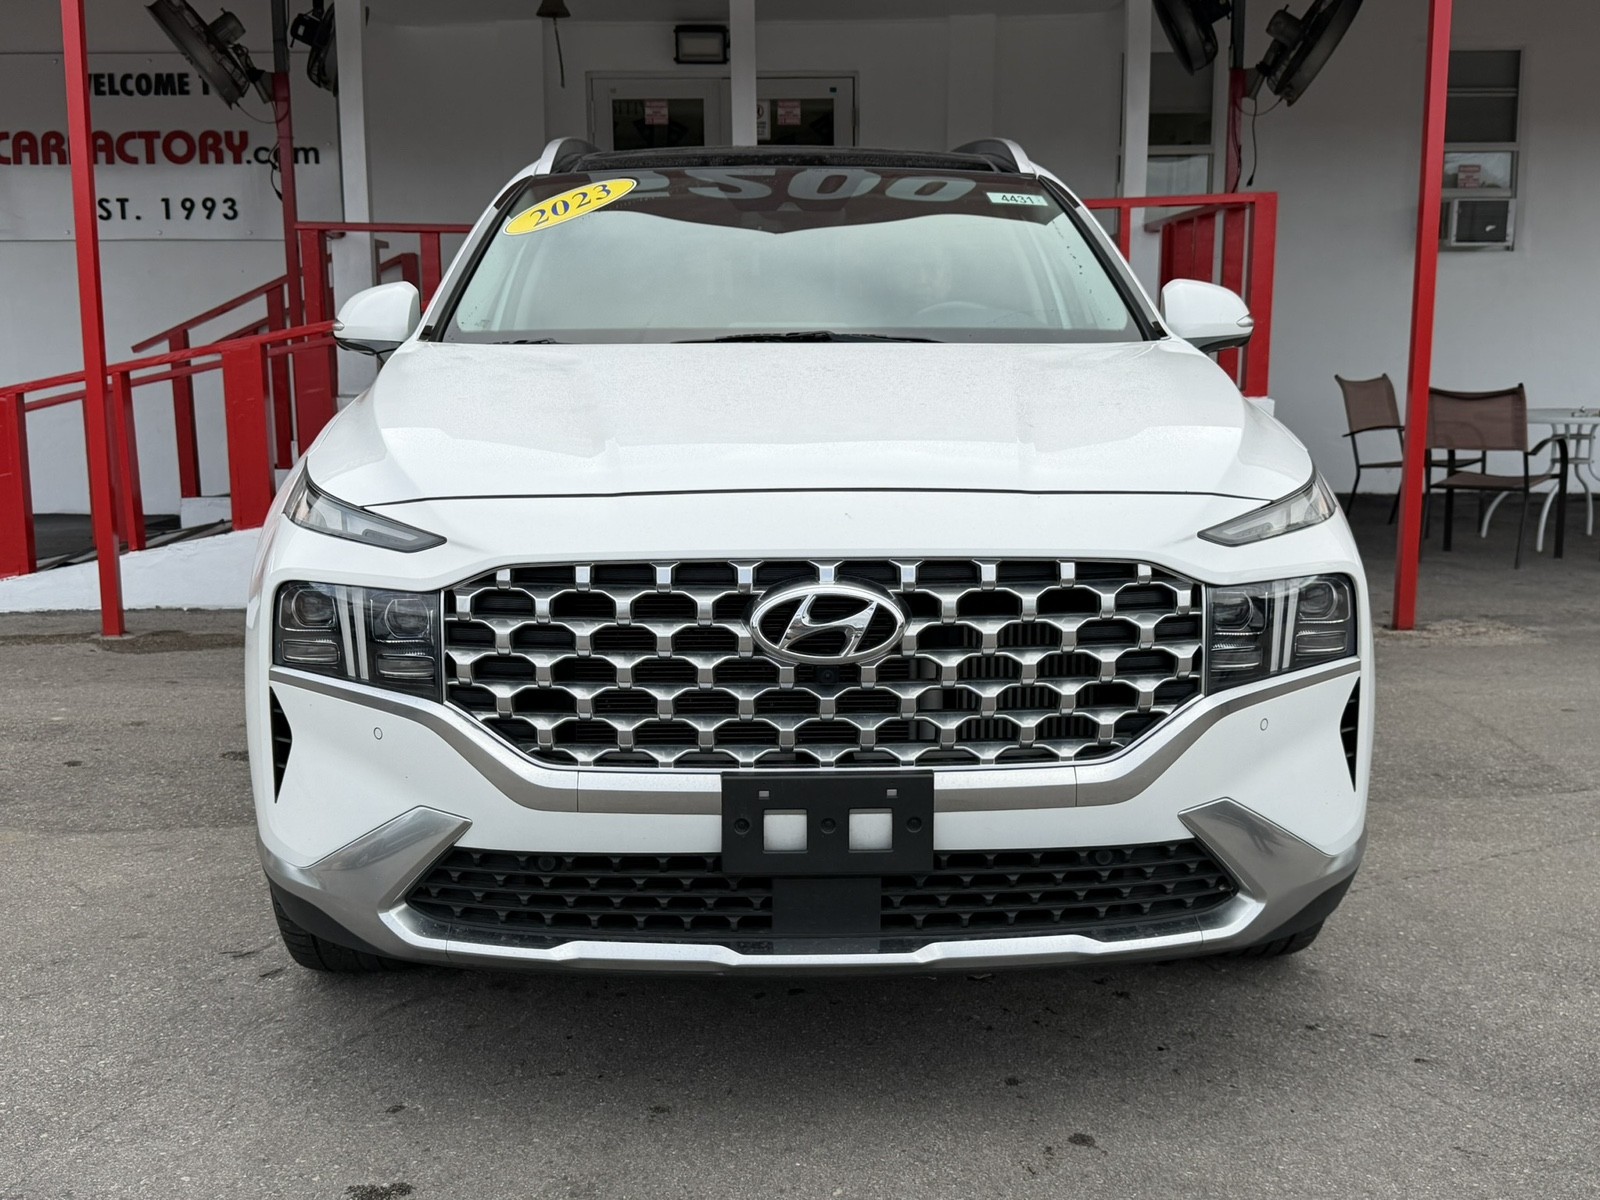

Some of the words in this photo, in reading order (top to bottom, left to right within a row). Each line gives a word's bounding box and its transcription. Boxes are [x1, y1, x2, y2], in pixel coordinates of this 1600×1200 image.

[88, 73, 190, 96] ELCOME
[97, 197, 141, 220] ST.
[161, 197, 239, 220] 1993
[529, 184, 612, 228] 2023
[1001, 194, 1034, 204] 4431
